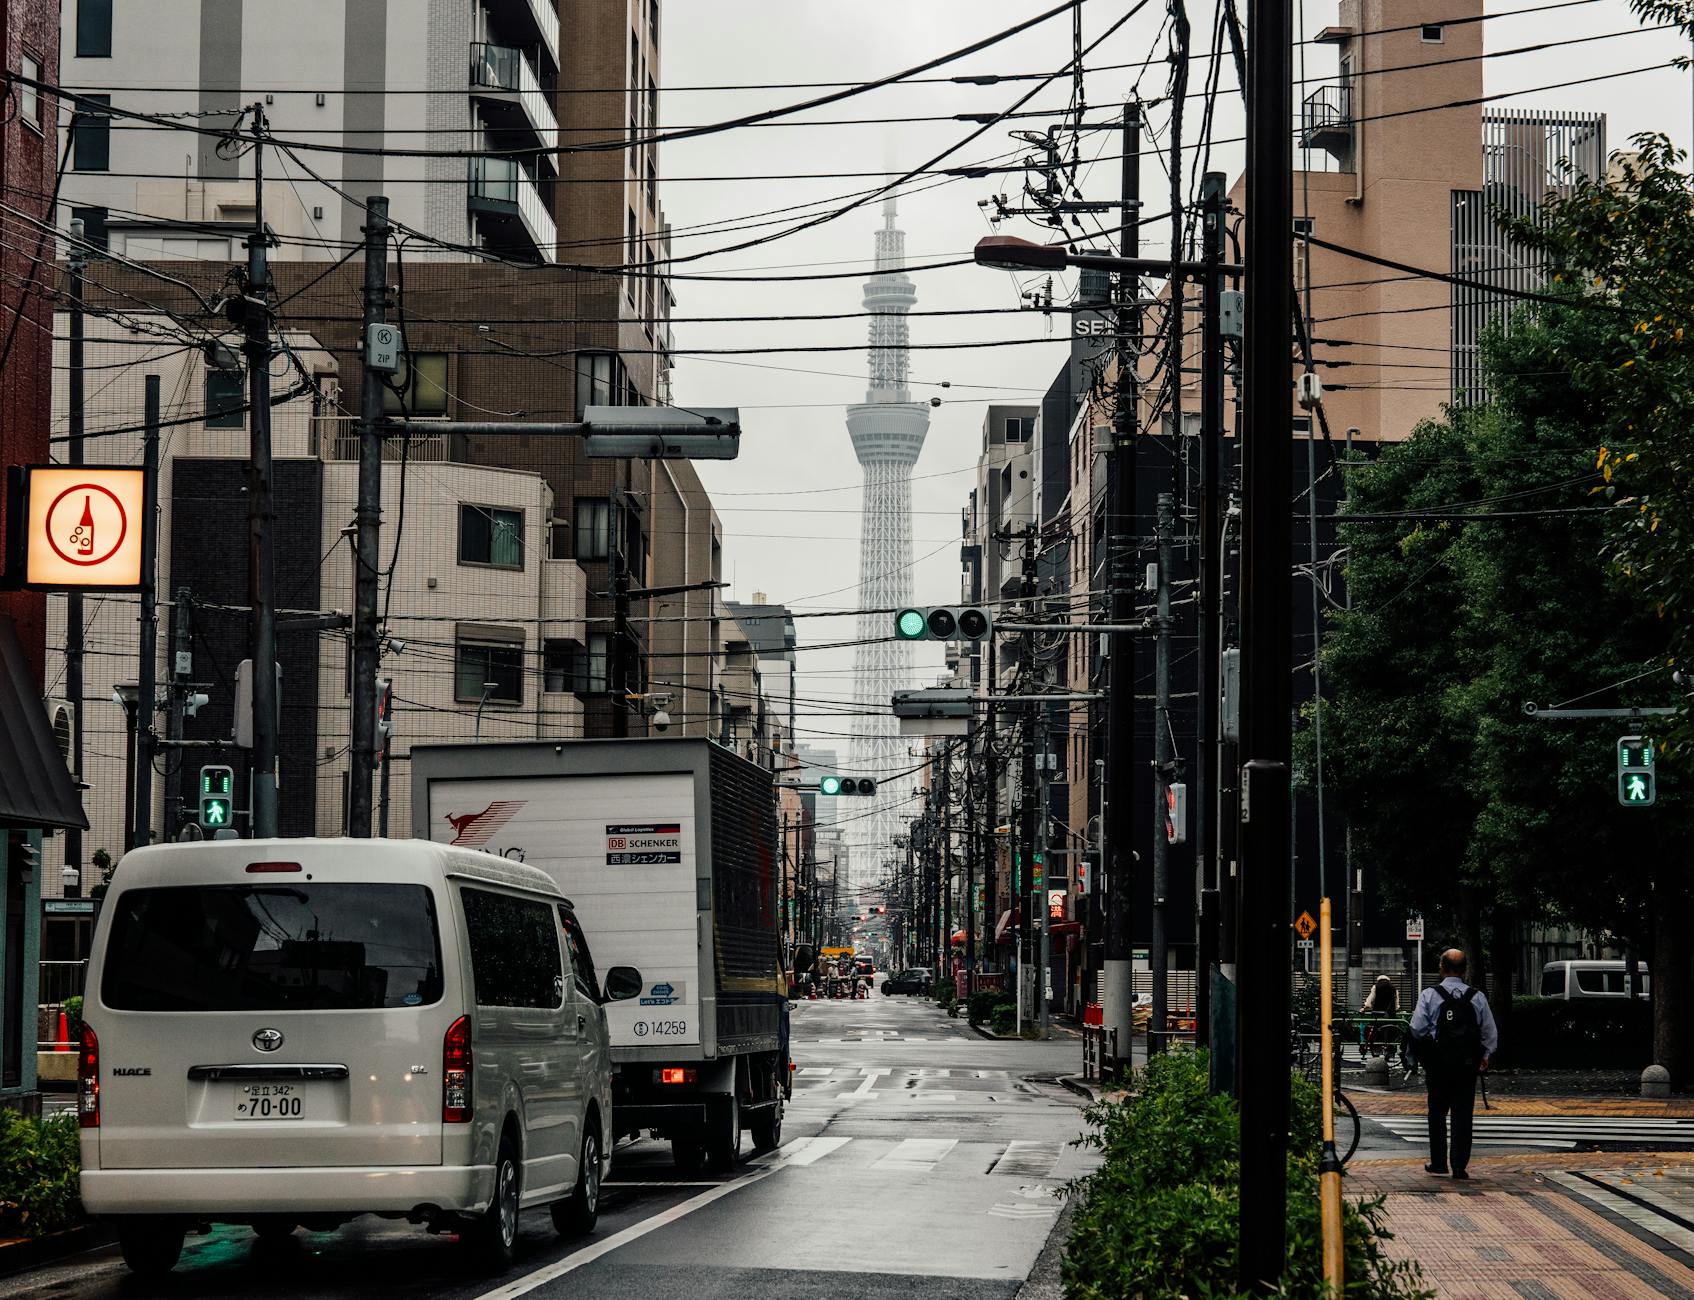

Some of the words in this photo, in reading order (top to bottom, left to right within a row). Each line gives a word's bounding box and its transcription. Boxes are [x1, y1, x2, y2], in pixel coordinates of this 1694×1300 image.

[611, 839, 624, 848] DB
[629, 839, 678, 848] SCHENKER
[610, 853, 677, 864] 西濃シェンカー
[1446, 1009, 1454, 1021] e
[651, 1020, 687, 1036] 14259
[112, 1067, 152, 1077] HIACE
[250, 1085, 271, 1096] 足立
[272, 1085, 290, 1096] 342
[237, 1103, 248, 1112] め
[249, 1097, 301, 1117] 70-00
